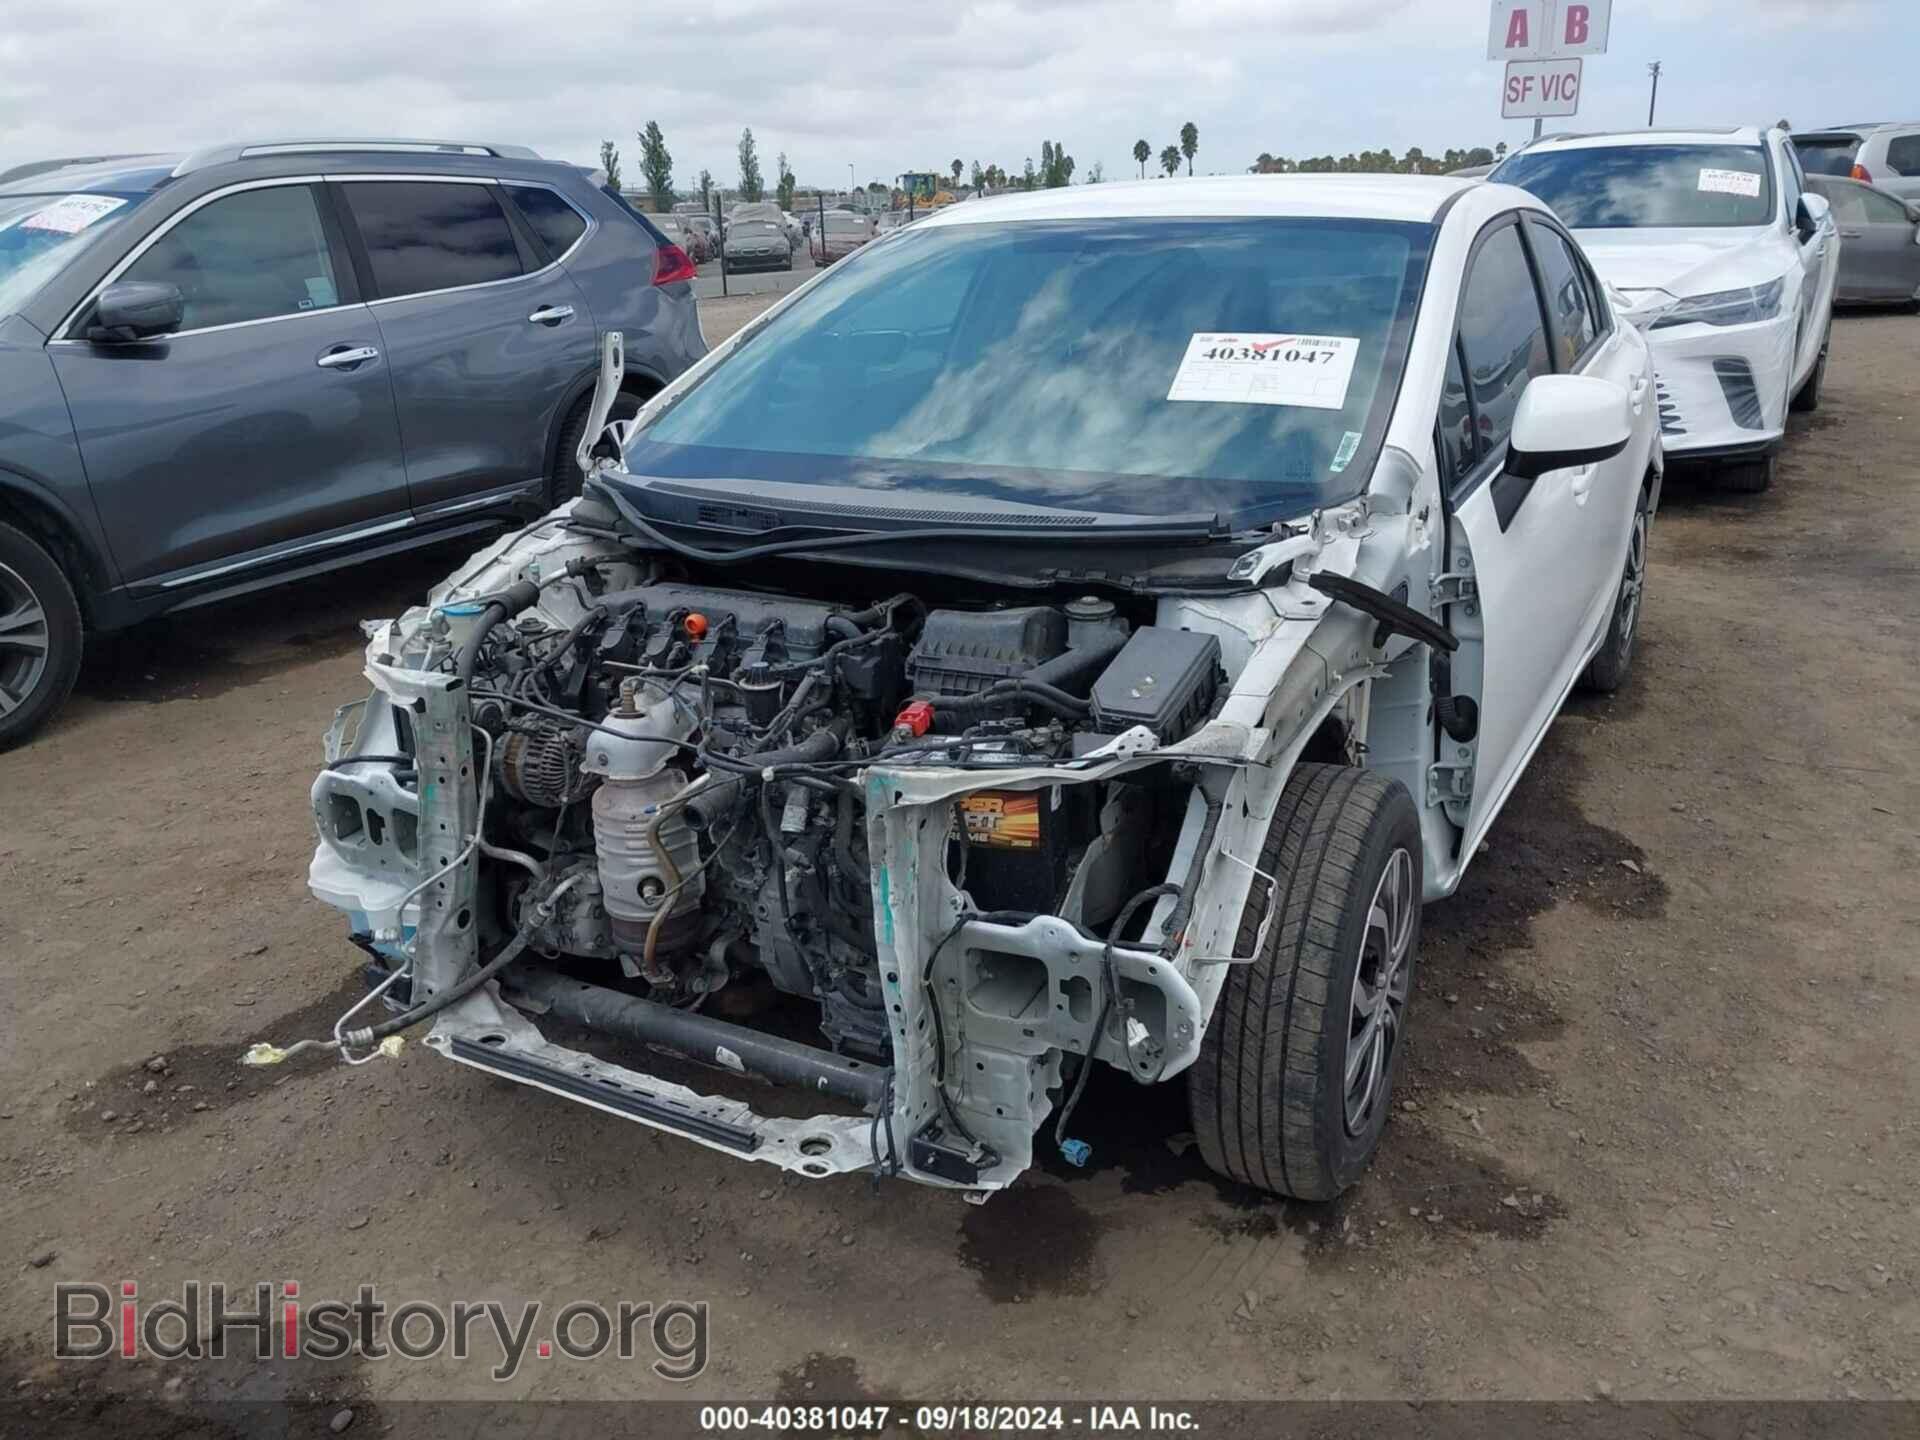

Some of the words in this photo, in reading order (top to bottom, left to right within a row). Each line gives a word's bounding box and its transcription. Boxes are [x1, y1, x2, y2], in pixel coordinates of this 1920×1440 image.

[1505, 9, 1528, 48] A
[1565, 5, 1589, 44] B
[1507, 76, 1534, 103] SF
[1541, 73, 1577, 101] VIC
[1202, 348, 1334, 364] 40381047
